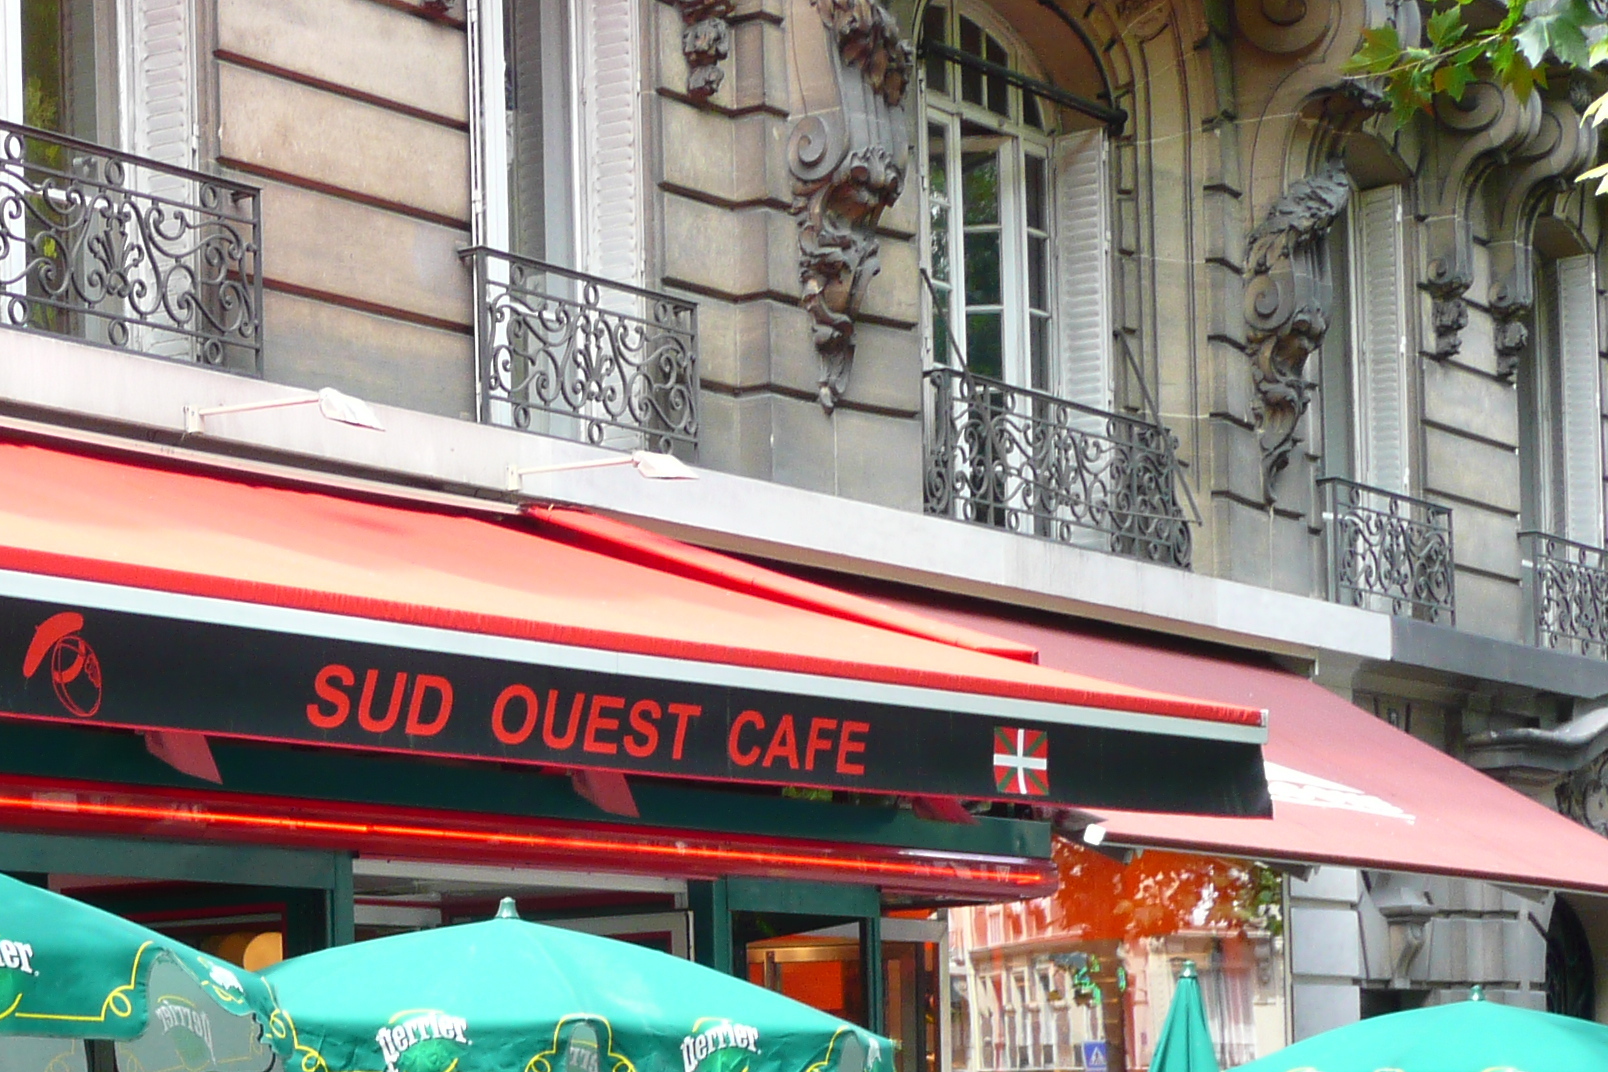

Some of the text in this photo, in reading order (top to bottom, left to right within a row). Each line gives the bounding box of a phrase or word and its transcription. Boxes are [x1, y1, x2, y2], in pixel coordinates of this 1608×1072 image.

[306, 663, 869, 775] SUD OUEST CAFE
